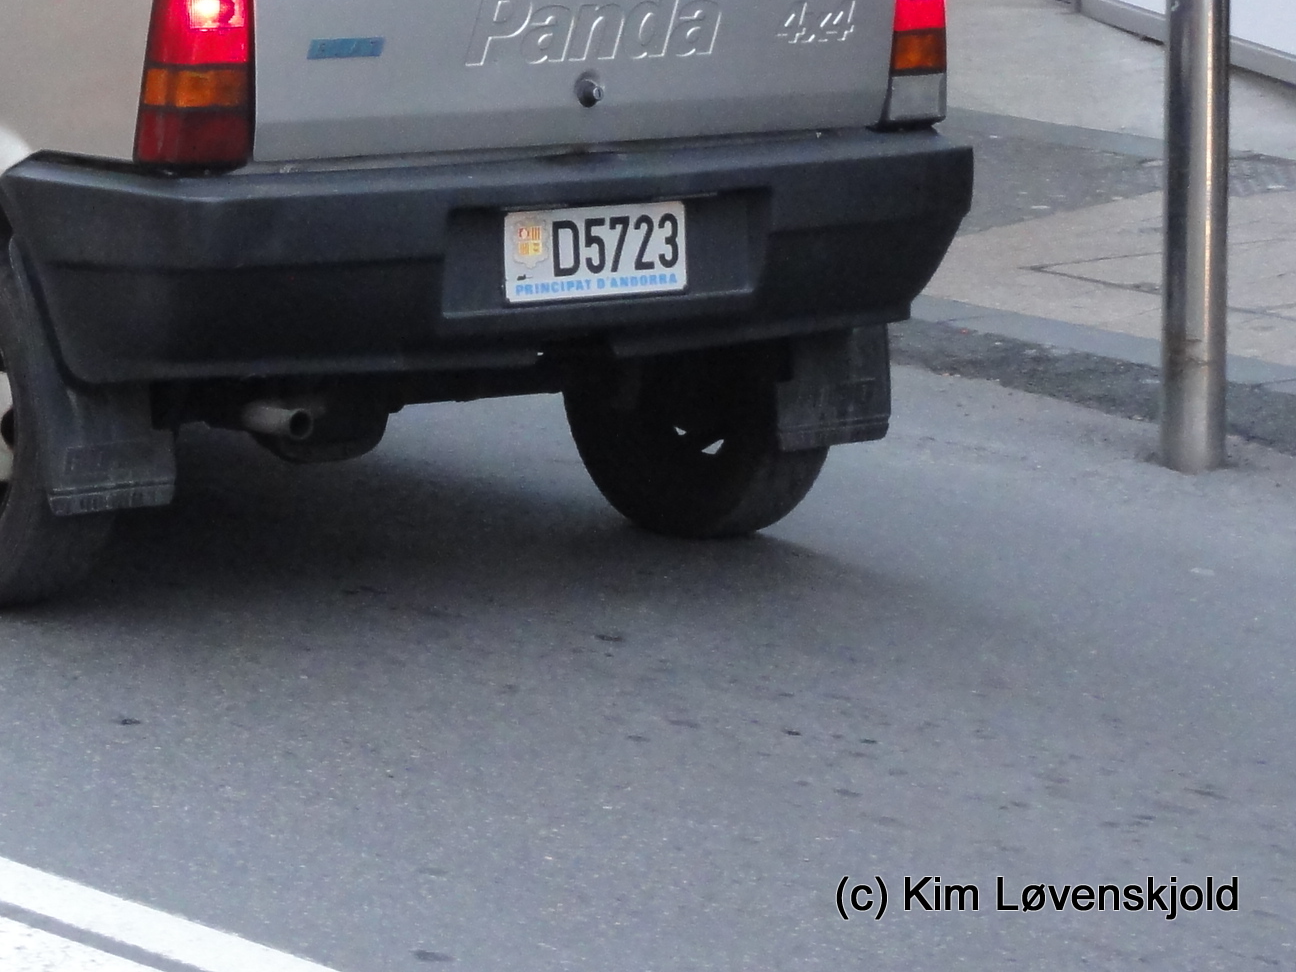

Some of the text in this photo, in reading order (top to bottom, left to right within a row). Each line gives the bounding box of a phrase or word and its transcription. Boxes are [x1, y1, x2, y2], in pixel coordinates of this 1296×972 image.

[776, 0, 856, 44] 4x4
[552, 212, 679, 278] D5723
[515, 273, 678, 296] PRINCIPAT D'ANDORRA
